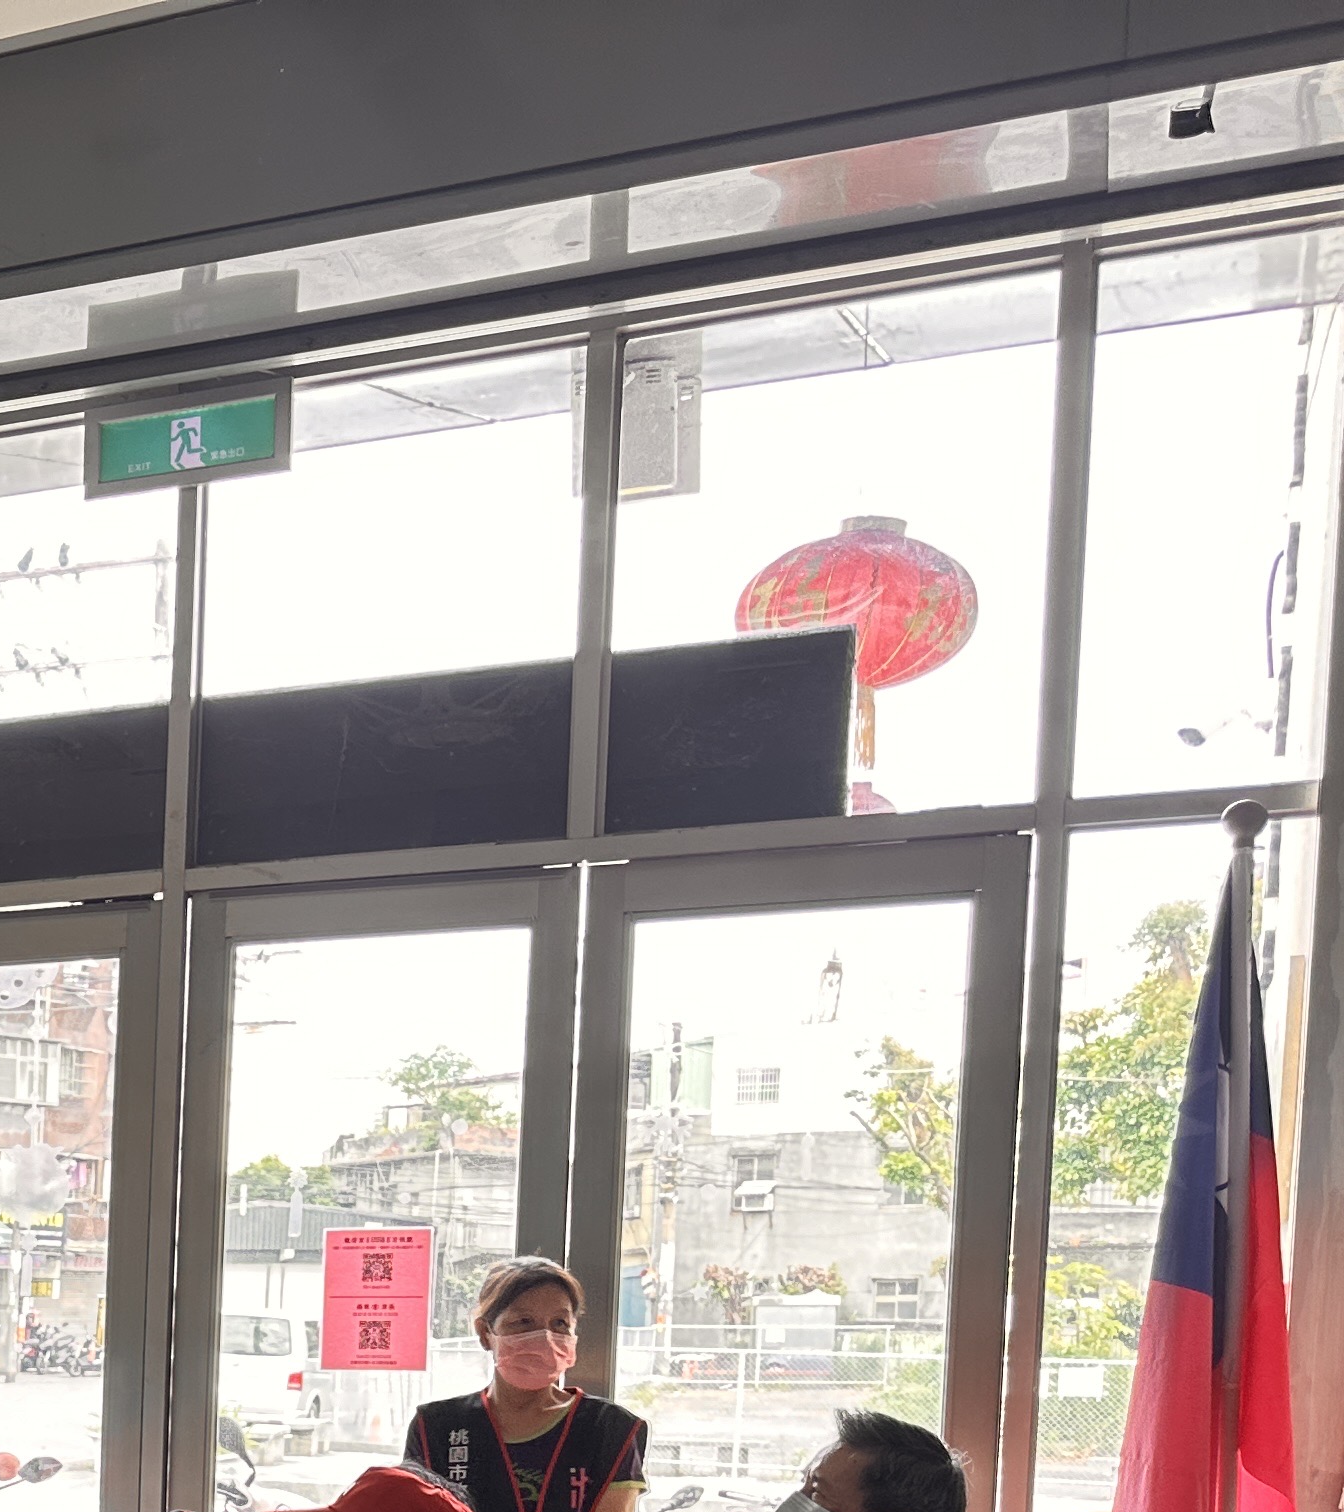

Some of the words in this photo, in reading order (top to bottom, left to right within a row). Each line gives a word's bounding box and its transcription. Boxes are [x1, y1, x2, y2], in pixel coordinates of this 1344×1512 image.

[210, 446, 245, 461] 緊急出口
[127, 461, 152, 473] EXIT
[448, 1428, 470, 1490] 桃園市
